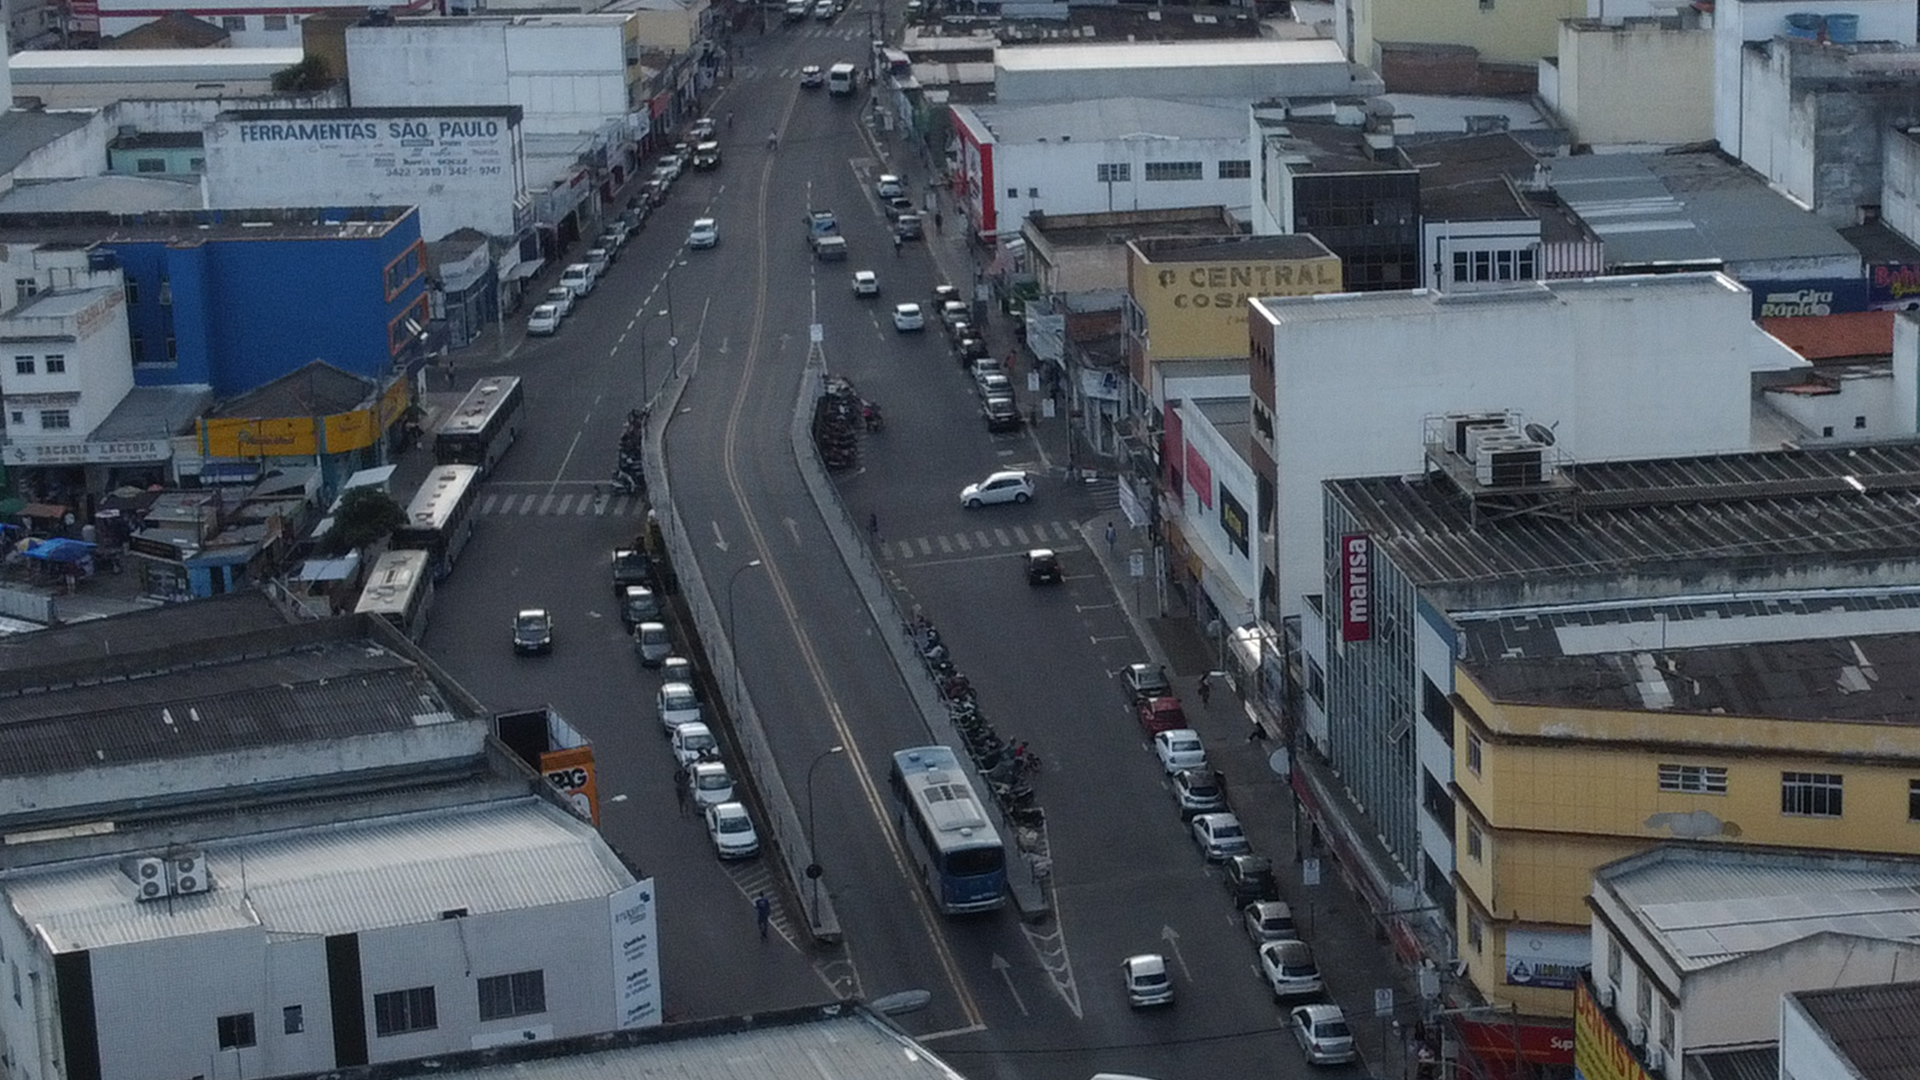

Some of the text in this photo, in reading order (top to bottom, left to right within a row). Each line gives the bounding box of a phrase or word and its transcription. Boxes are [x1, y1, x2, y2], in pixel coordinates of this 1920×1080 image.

[240, 123, 377, 141] FERRAMENTAS
[440, 121, 498, 137] PAULO
[1190, 265, 1334, 288] CENTRAL
[1349, 538, 1368, 622] marisa
